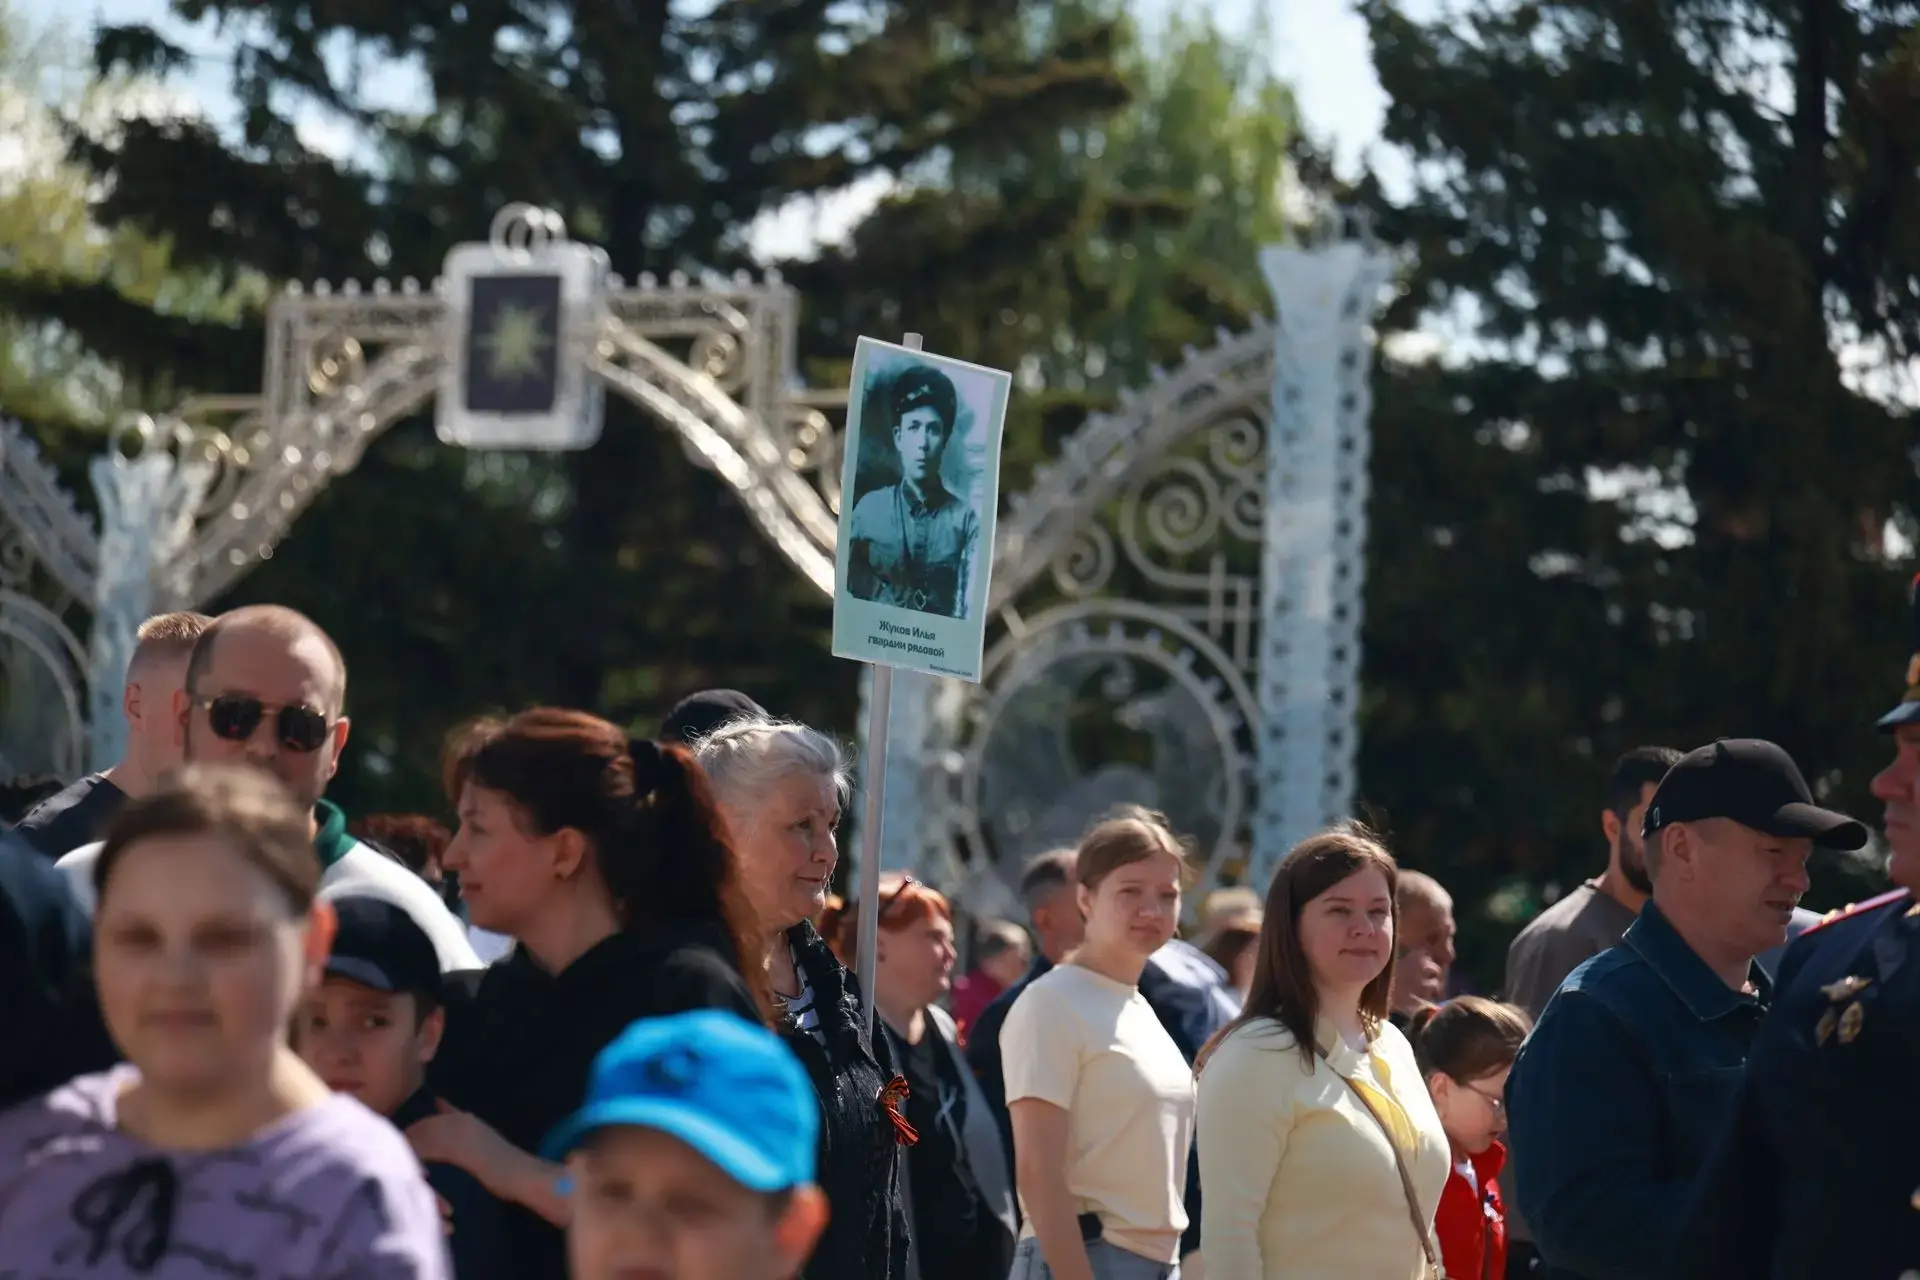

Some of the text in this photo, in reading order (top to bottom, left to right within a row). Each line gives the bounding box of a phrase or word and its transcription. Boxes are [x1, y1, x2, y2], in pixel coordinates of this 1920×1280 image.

[879, 620, 936, 640] Жуков Илья
[868, 635, 945, 657] гвардии рядовой
